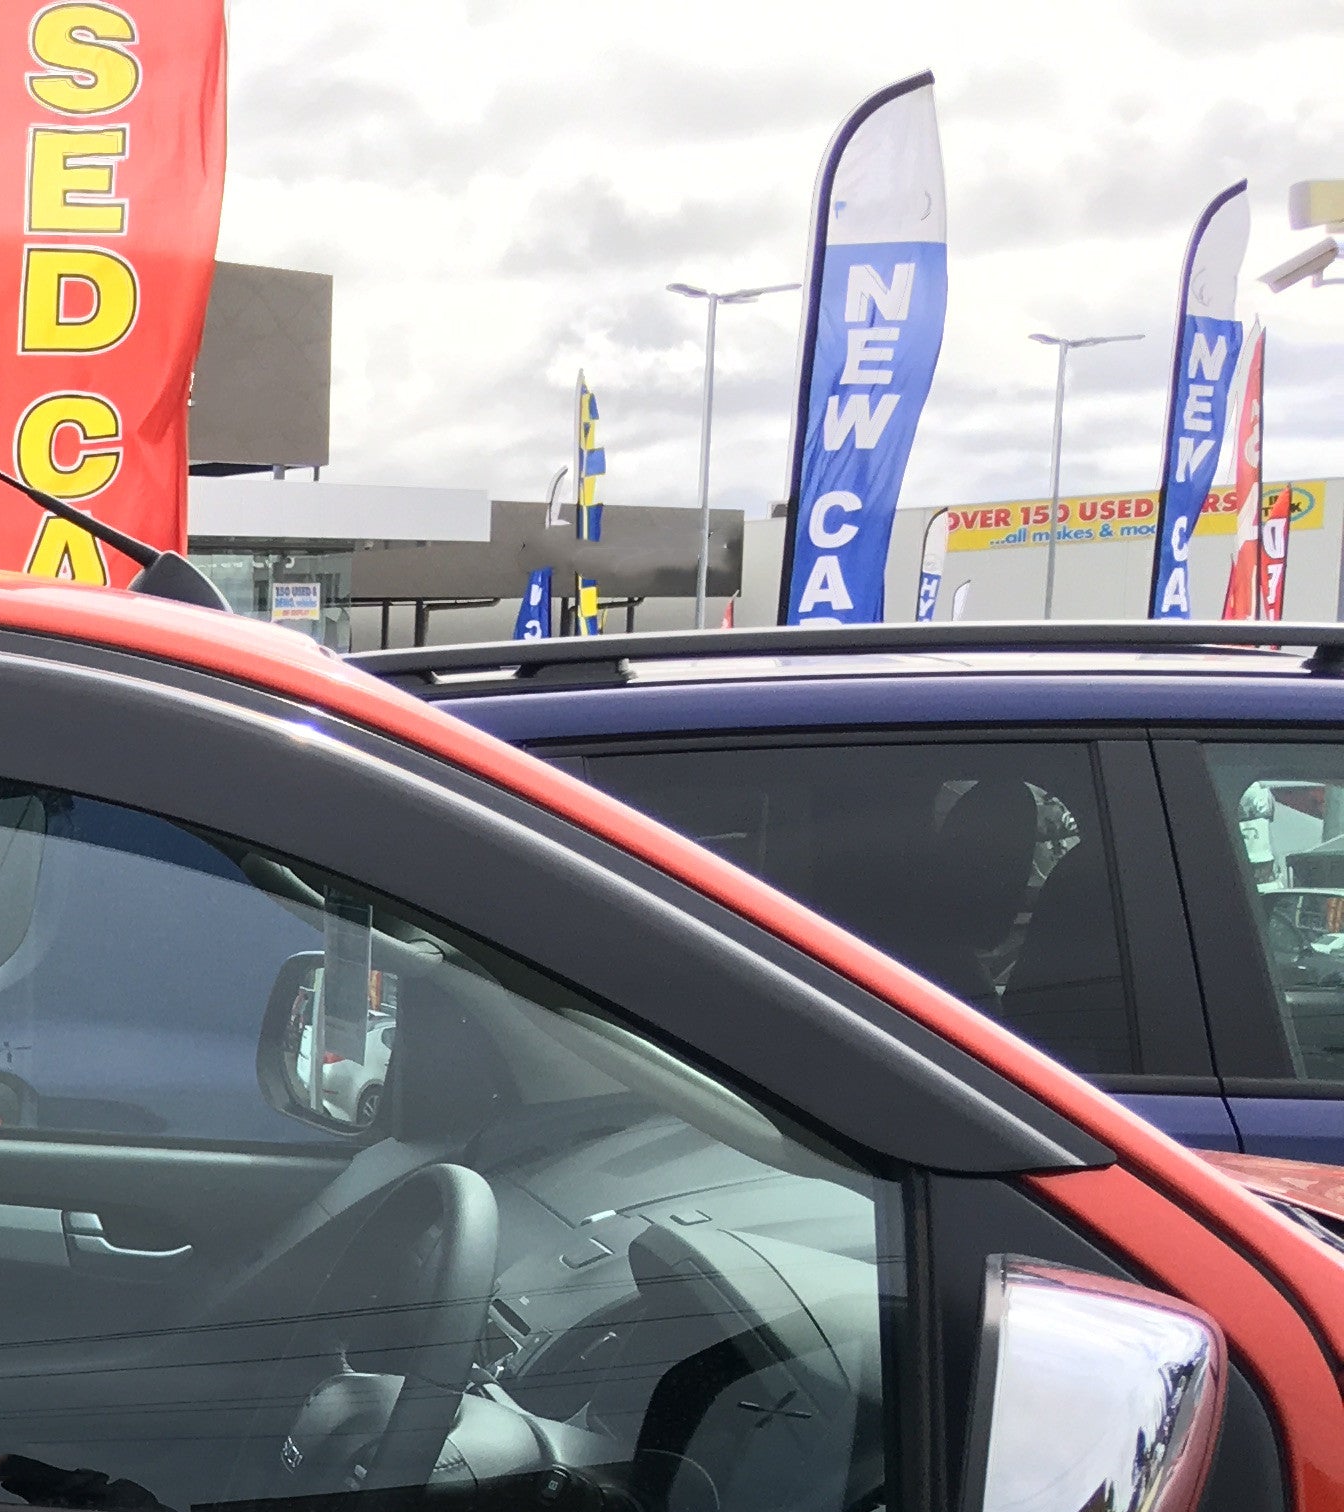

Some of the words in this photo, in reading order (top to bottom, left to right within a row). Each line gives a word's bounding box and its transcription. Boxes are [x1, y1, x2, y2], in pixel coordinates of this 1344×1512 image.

[823, 262, 916, 451] NEW
[1020, 502, 1071, 526] 150
[1078, 498, 1154, 523] USED
[1099, 523, 1113, 537] &
[796, 490, 863, 626] CA
